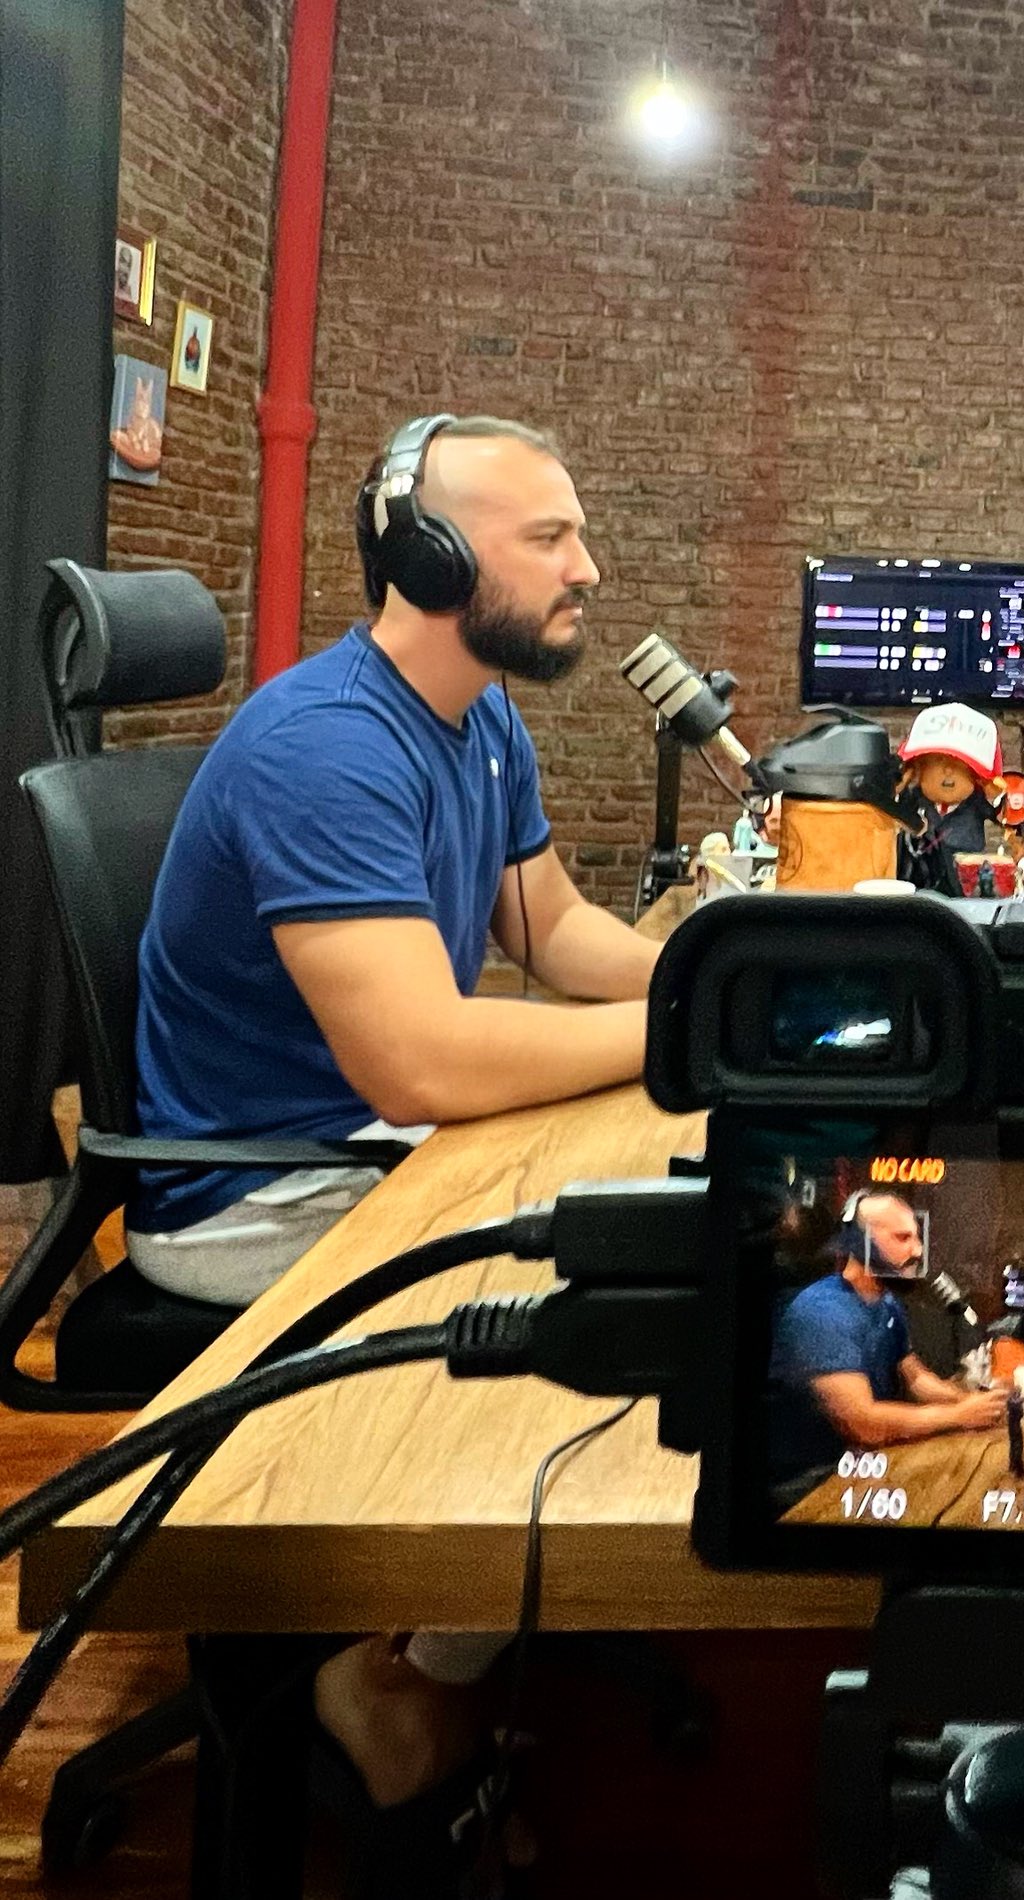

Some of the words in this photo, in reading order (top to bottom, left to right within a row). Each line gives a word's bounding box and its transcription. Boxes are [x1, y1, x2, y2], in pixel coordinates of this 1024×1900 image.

[871, 1157, 898, 1182] NO
[899, 1158, 945, 1184] CARD
[841, 1486, 907, 1520] 1/60
